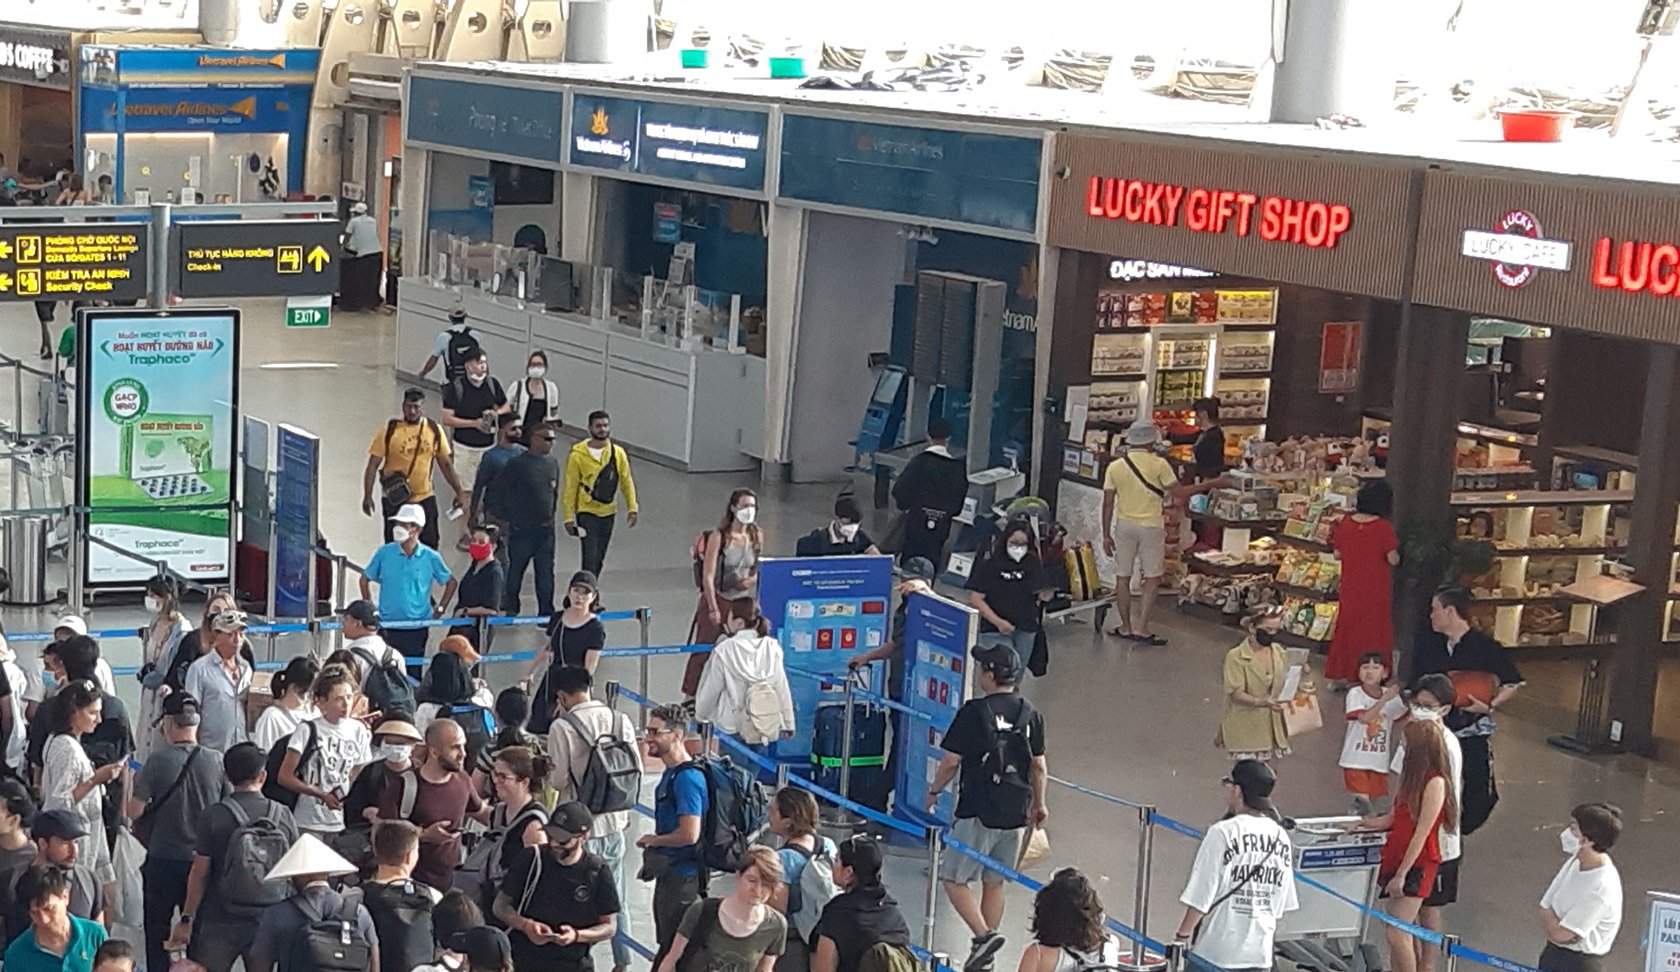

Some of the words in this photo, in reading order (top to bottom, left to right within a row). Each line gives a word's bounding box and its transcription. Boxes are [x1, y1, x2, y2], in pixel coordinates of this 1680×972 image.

[1089, 175, 1183, 227] LUCKY
[1186, 189, 1257, 237] GIFT
[1260, 195, 1351, 249] SHOP
[1502, 211, 1533, 231] LUCKY
[71, 270, 91, 279] TRA
[92, 270, 105, 279] AN
[1592, 237, 1680, 298] LUC
[46, 282, 83, 293] Security
[84, 281, 113, 290] Check
[294, 309, 314, 323] EXIT
[112, 342, 134, 354] HOẠT
[136, 339, 162, 352] HUYẾT
[128, 354, 191, 367] Traphaco
[135, 540, 180, 550] Traphaco
